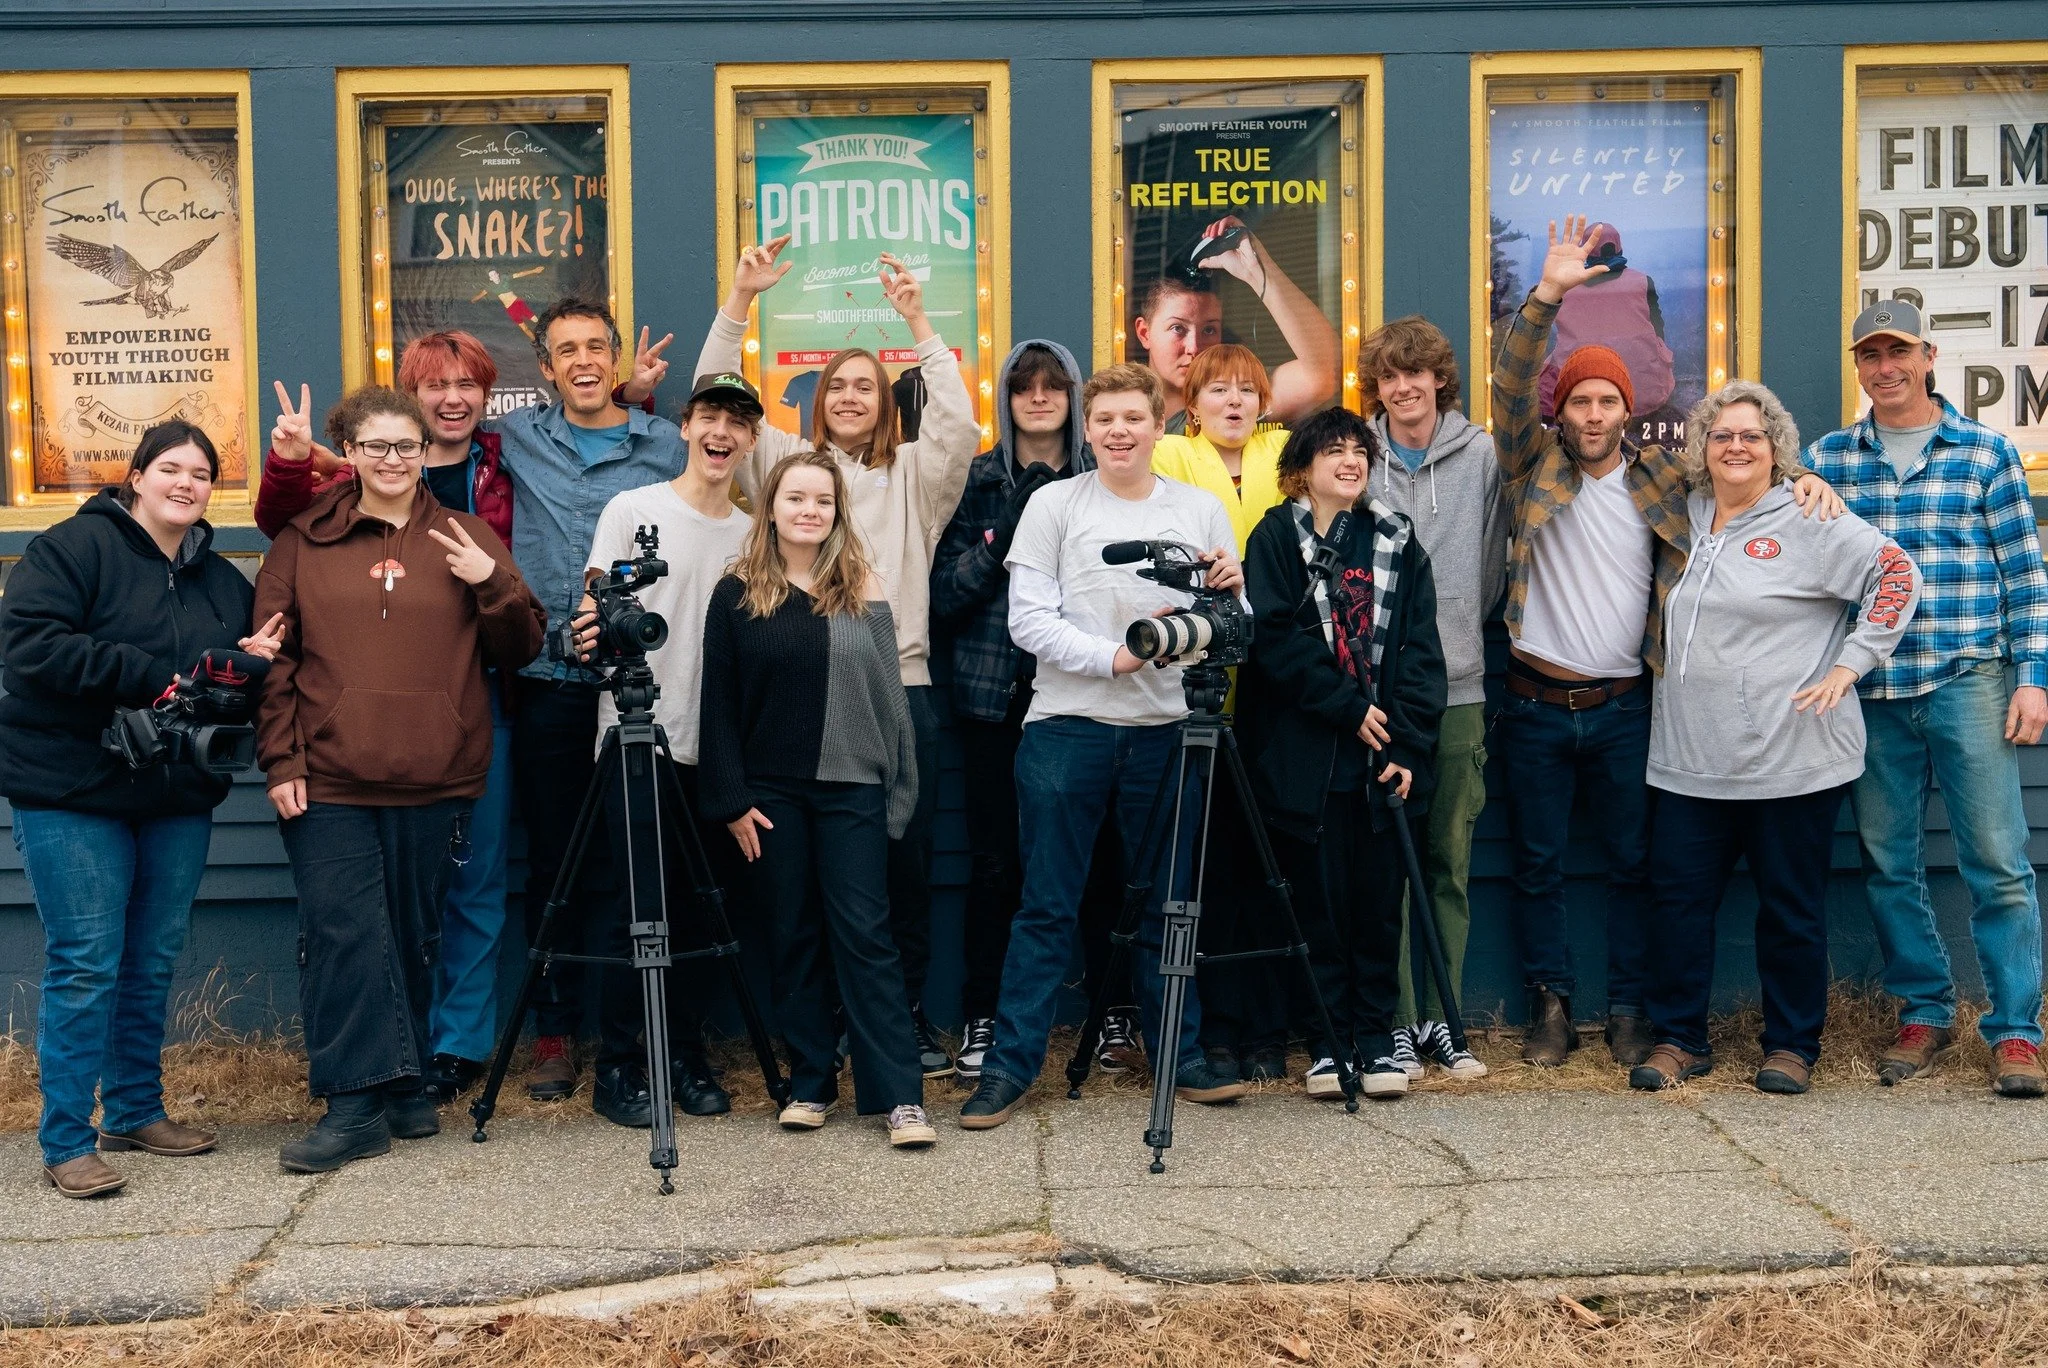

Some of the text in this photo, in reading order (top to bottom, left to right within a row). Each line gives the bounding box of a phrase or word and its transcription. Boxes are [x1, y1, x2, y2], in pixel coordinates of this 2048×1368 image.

[1158, 120, 1308, 133] SMOOTH FEATHER YOUTH
[1511, 119, 1683, 128] A SMOOTH FEATHER FILM
[456, 135, 499, 158] Smooth
[815, 138, 909, 161] THANK YOU!
[1509, 146, 1686, 168] SILENTLY
[1879, 123, 2048, 190] FILM
[482, 157, 521, 166] PRESENTS
[1195, 148, 1271, 173] TRUE
[405, 177, 466, 206] DUDE,
[475, 175, 561, 202] WHERE'S
[1130, 179, 1327, 207] REFLECTION
[1508, 170, 1686, 197] UNITED
[41, 184, 128, 226] Smooth
[761, 178, 971, 251] PATRONS
[433, 204, 584, 260] SNAKE?!
[803, 264, 858, 284] Become
[861, 257, 881, 274] A
[65, 327, 211, 347] EMPOWERING
[48, 347, 230, 367] YOUTH THROUGH
[73, 367, 214, 387] FILMMAKING
[97, 410, 130, 435] KEZAR
[1333, 516, 1349, 543] DEITY
